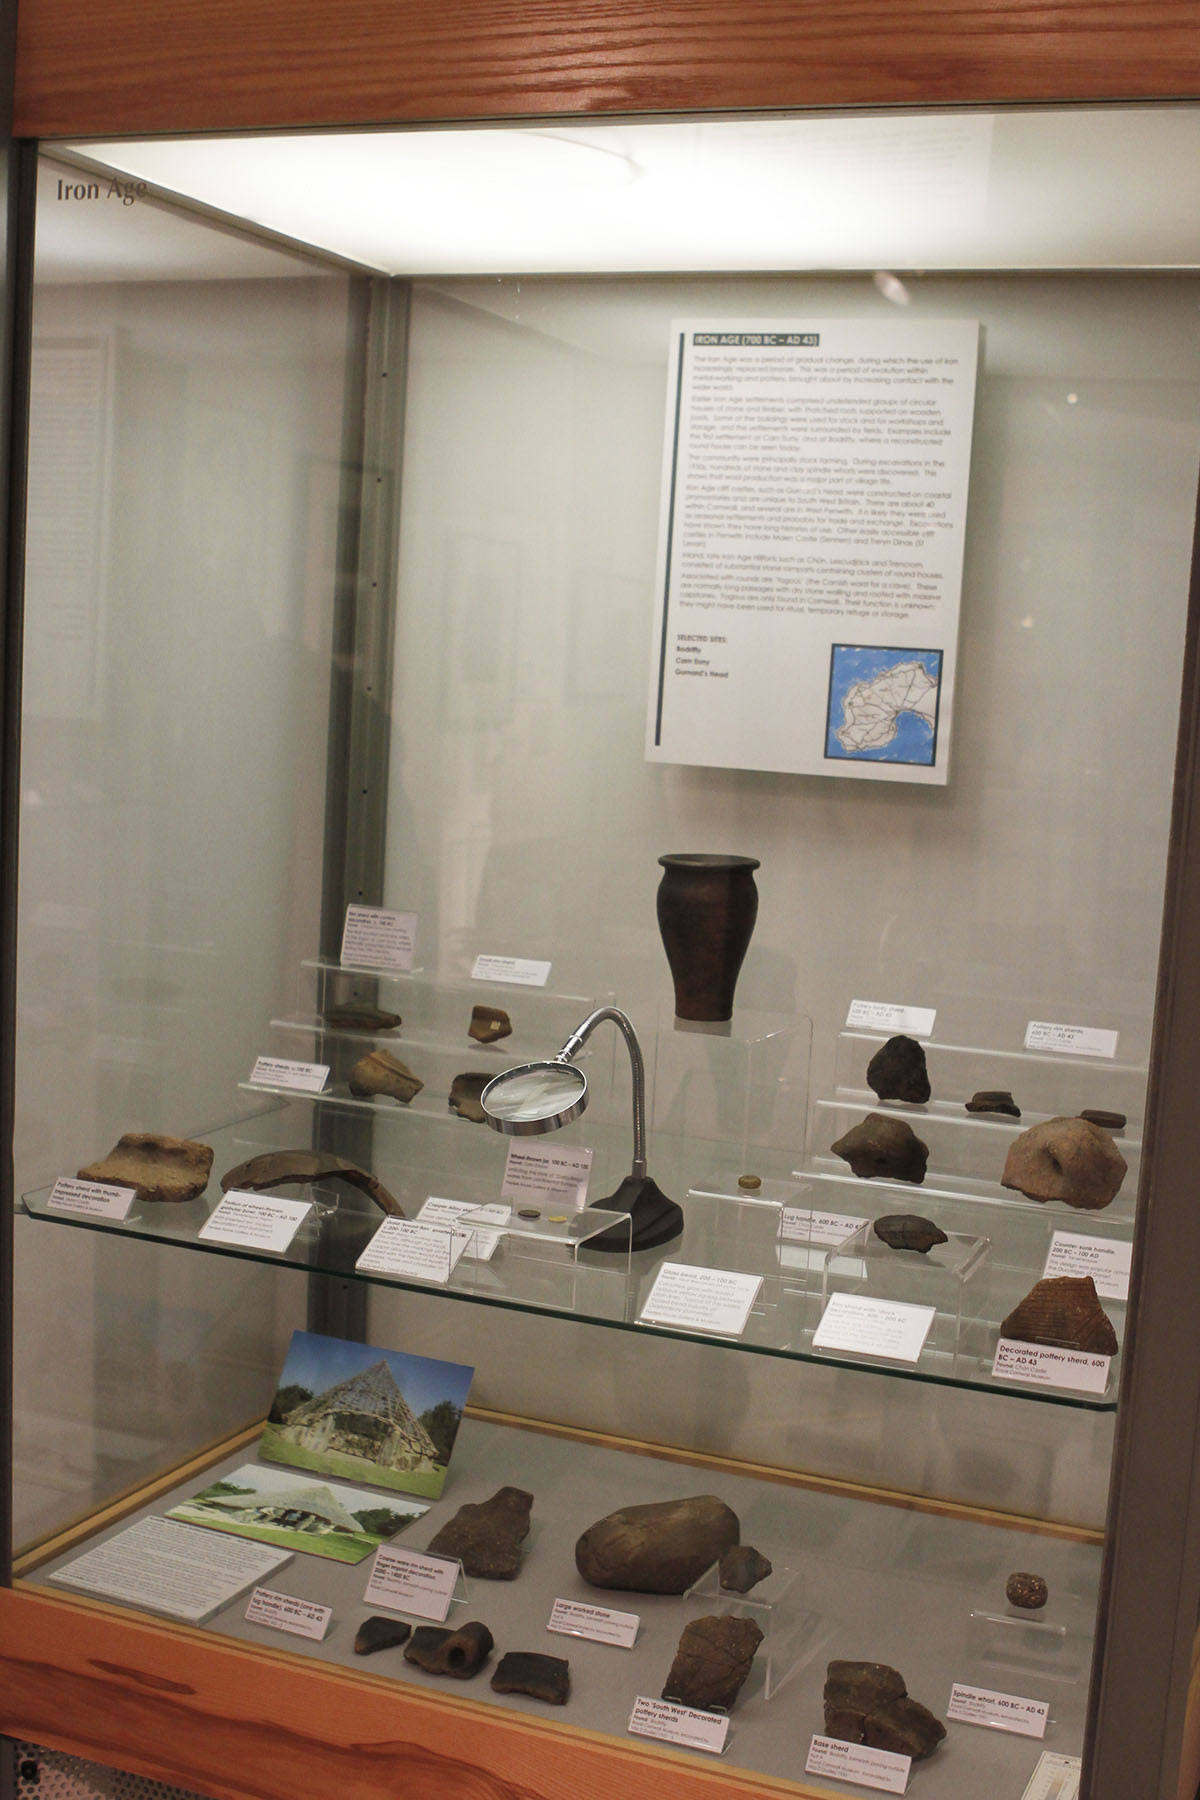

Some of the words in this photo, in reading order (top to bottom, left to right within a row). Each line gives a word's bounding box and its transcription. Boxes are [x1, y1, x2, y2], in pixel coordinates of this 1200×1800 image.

[57, 179, 99, 201] Iron
[107, 177, 148, 206] Age
[695, 335, 718, 345] IRON
[720, 335, 740, 345] AGE
[742, 335, 761, 346] (700
[764, 336, 777, 345] BC
[786, 336, 800, 345] AD
[802, 336, 817, 346] 43)
[795, 356, 823, 366] gradual
[858, 357, 881, 366] during
[883, 357, 905, 365] which
[837, 366, 860, 375] period
[819, 376, 842, 384] about
[853, 376, 891, 386] increasing
[893, 377, 922, 385] contact
[874, 399, 898, 408] groups
[909, 399, 936, 407] circular
[805, 406, 838, 415] thatched
[859, 408, 897, 417] supported
[910, 409, 941, 417] wooden
[889, 418, 926, 427] workshops
[888, 427, 921, 437] Examples
[924, 428, 951, 436] include
[891, 438, 943, 446] reconstructed
[853, 457, 876, 467] During
[878, 458, 922, 467] excavations
[855, 477, 878, 486] village
[867, 489, 910, 498] constructed
[924, 491, 952, 500] coastal
[866, 499, 885, 507] There
[902, 500, 924, 508] about
[927, 511, 946, 520] used
[866, 518, 903, 528] exchange.
[837, 526, 857, 534] Other
[859, 528, 880, 537] easily
[882, 528, 919, 537] accessible
[872, 559, 887, 568] and
[816, 567, 855, 577] containing
[857, 568, 882, 577] clusters
[894, 570, 916, 578] round
[822, 578, 847, 587] Cornish
[850, 580, 868, 588] word
[917, 583, 937, 591] These
[826, 588, 850, 598] walling
[853, 590, 867, 598] and
[869, 590, 894, 599] roofed
[807, 596, 840, 606] Cornwall.
[845, 598, 860, 607] Their
[863, 598, 893, 608] function
[808, 606, 844, 616] temporary
[846, 608, 869, 618] refuge
[881, 610, 909, 619] storage.
[677, 634, 708, 642] SELECTED
[676, 646, 701, 654] Bodrifty
[694, 658, 710, 666] Euny
[675, 668, 707, 677] Gurnard's
[710, 671, 728, 679] Head
[1032, 1024, 1052, 1032] Pottery
[57, 1182, 74, 1190] Pottery
[76, 1185, 90, 1193] sherd
[81, 1193, 110, 1203] decoration
[220, 1205, 240, 1214] globular
[784, 1213, 795, 1221] Lug
[387, 1219, 400, 1227] Gold
[1054, 1241, 1078, 1249] Counter
[664, 1269, 679, 1277] Glass
[1000, 1345, 1038, 1358] Decorated
[1040, 1351, 1065, 1363] pottery
[1067, 1355, 1090, 1367] sherd,
[1091, 1360, 1105, 1368] 600
[1028, 1358, 1037, 1366] 43
[1031, 1366, 1047, 1374] Castle
[378, 1554, 396, 1563] Coarse
[419, 1564, 433, 1573] sherd
[253, 1597, 261, 1605] lug
[255, 1589, 273, 1599] Pottery
[283, 1598, 299, 1607] sherds
[301, 1602, 312, 1611] (one
[556, 1601, 571, 1610] Large
[573, 1606, 594, 1615] worked
[595, 1610, 610, 1618] stone
[953, 1690, 976, 1701] Spindle
[978, 1695, 996, 1705] whorl,
[998, 1699, 1009, 1708] 600
[1010, 1702, 1019, 1710] BC
[1026, 1705, 1035, 1713] AD
[1037, 1707, 1045, 1716] 43
[635, 1708, 657, 1718] pottery
[658, 1713, 678, 1723] sherds
[638, 1699, 649, 1707] Two
[652, 1702, 670, 1711] 'South
[671, 1707, 688, 1716] West'
[689, 1711, 722, 1725] Decorated
[813, 1739, 829, 1748] Base
[830, 1743, 849, 1753] sherd
